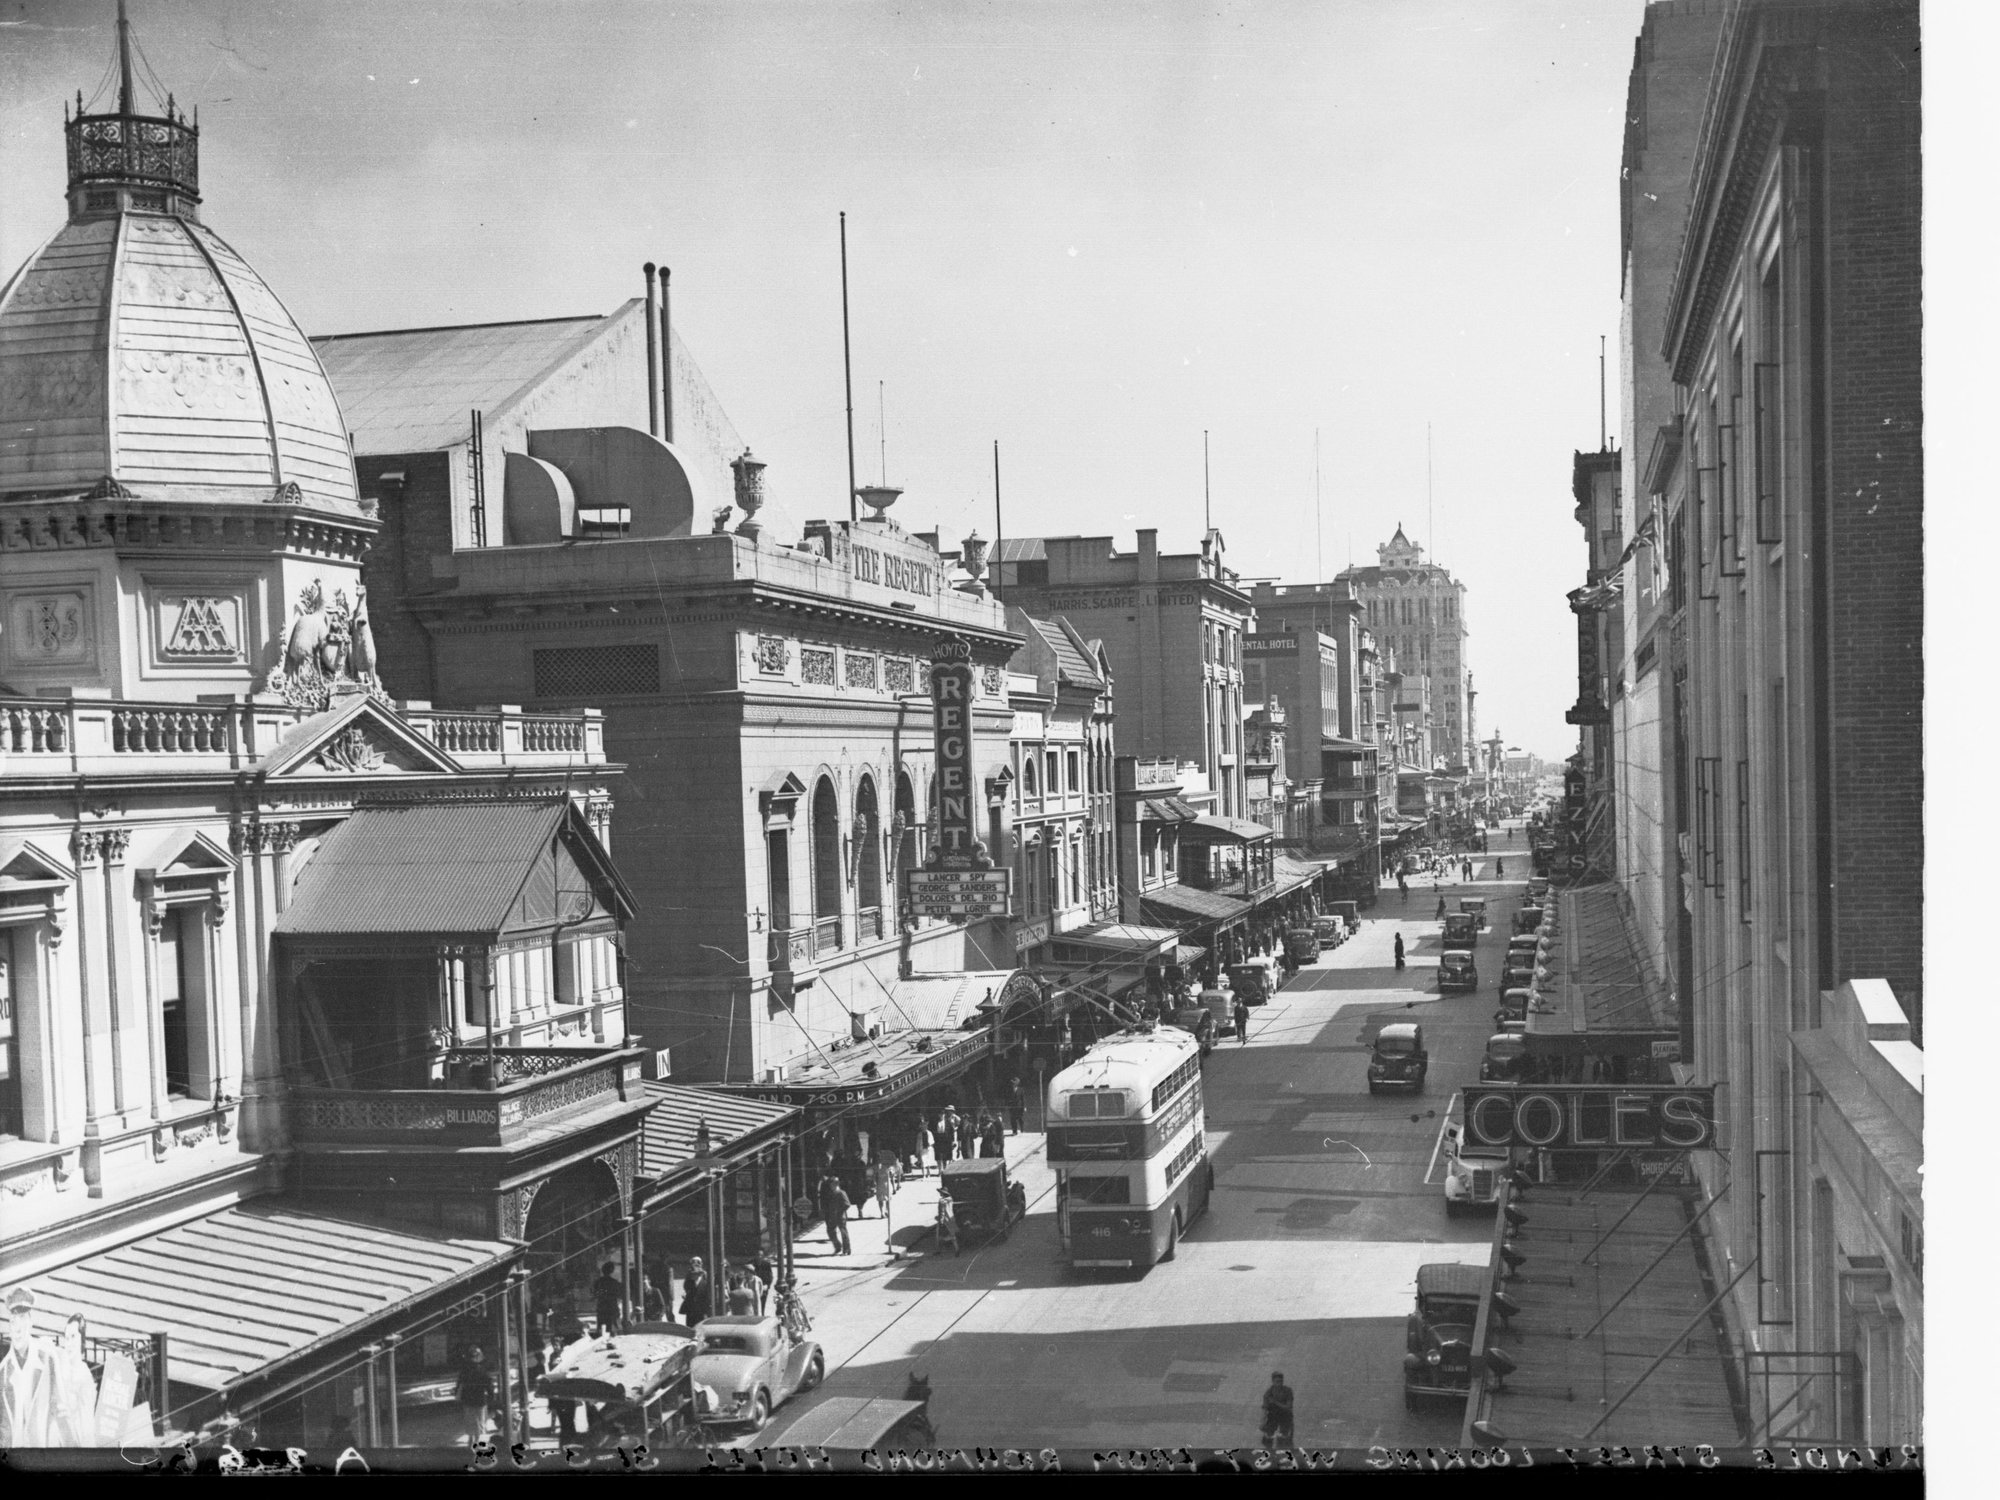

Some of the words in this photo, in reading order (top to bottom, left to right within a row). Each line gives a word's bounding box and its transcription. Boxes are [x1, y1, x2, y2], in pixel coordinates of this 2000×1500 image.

[851, 543, 881, 584] THE
[883, 552, 933, 599] REGENT
[1269, 639, 1297, 649] HOTEL
[932, 643, 966, 659] HOYTS
[938, 676, 970, 852] REGENT
[928, 873, 960, 882] LANCER
[969, 873, 986, 881] SPY
[918, 884, 950, 892] GEORGE
[959, 884, 997, 892] SANDERS
[919, 894, 956, 902] DOLORES
[961, 894, 977, 902] DEL
[982, 894, 997, 902] RIO
[925, 905, 951, 913] PETER
[964, 904, 991, 913] LORRE
[658, 1052, 671, 1077] IN
[447, 1109, 497, 1125] BILLIARDS
[1470, 1094, 1709, 1147] COLES
[1091, 1227, 1111, 1237] 416
